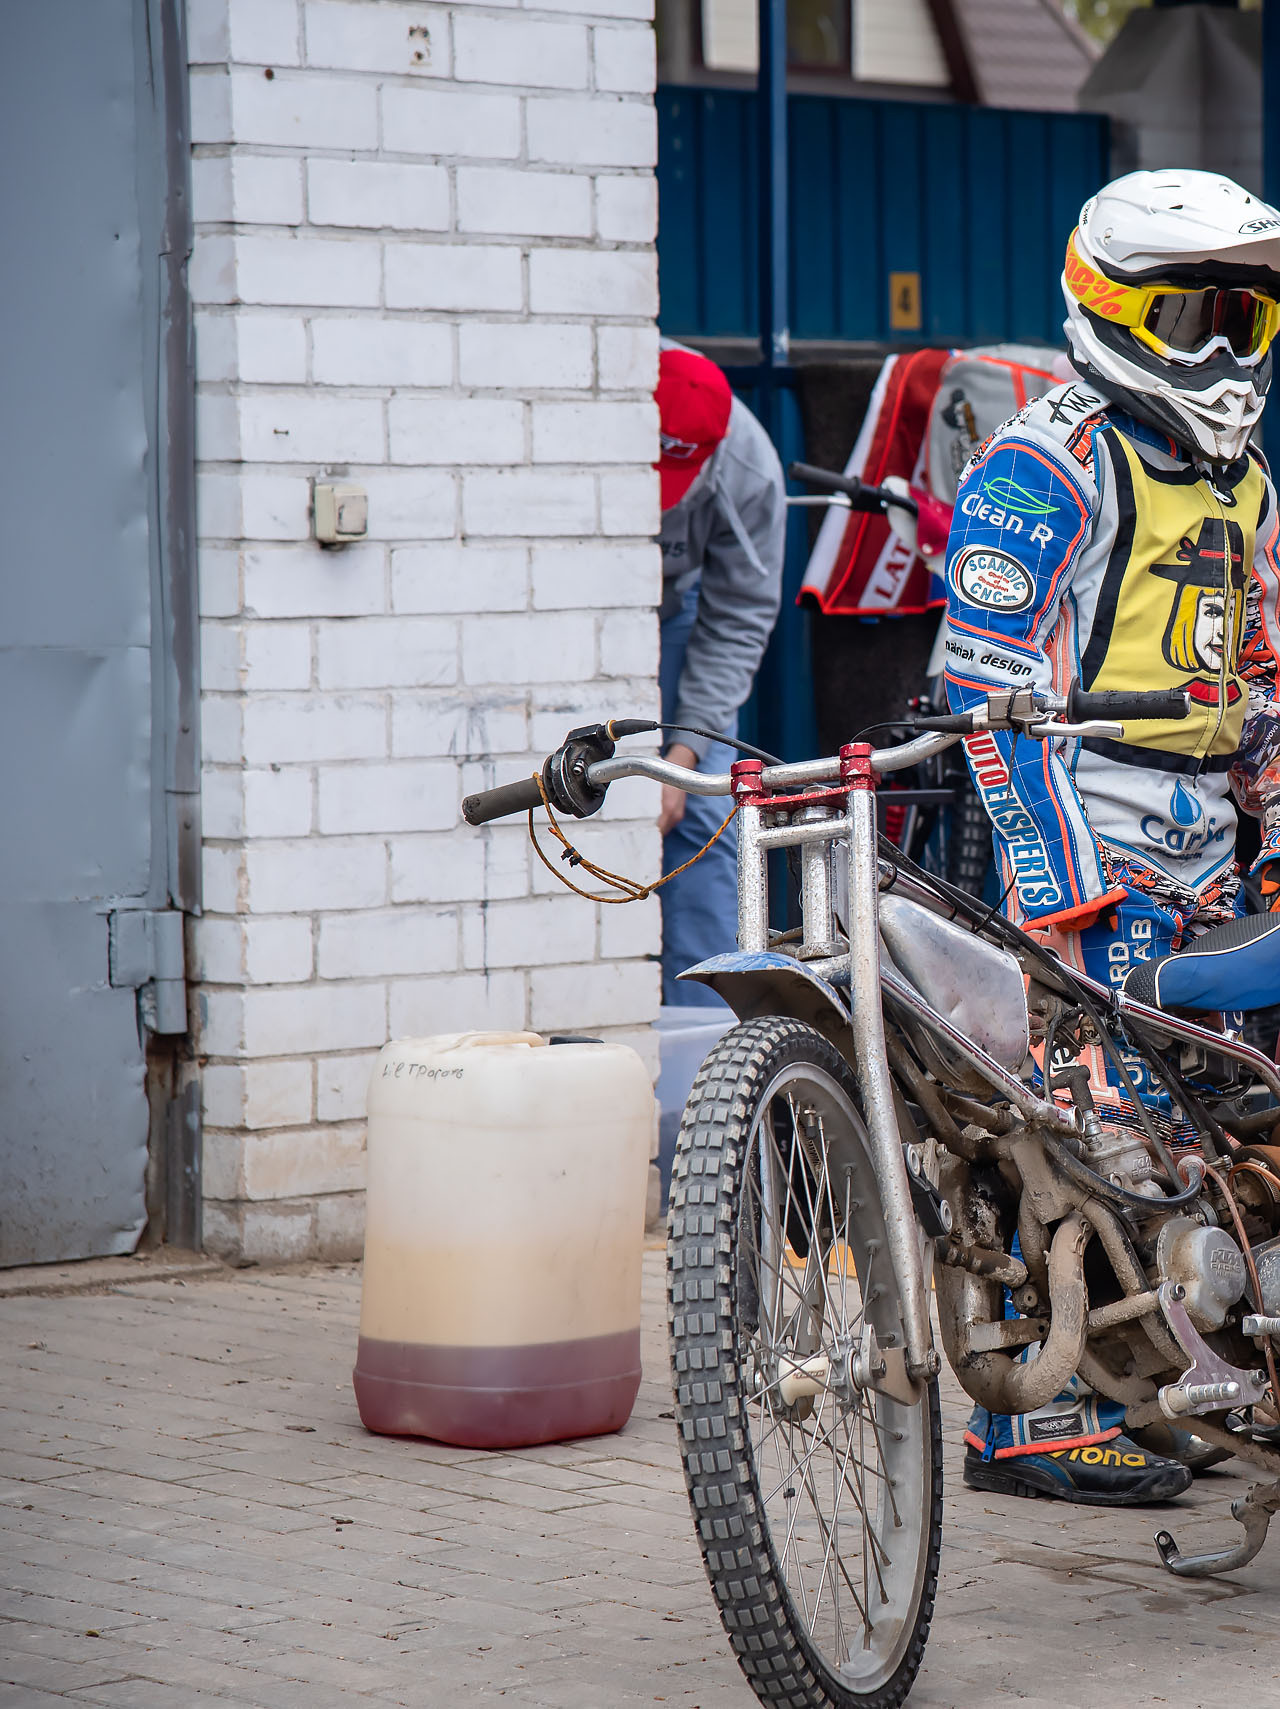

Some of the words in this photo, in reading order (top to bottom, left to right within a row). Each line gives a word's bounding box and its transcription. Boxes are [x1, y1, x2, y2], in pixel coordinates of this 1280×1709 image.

[961, 494, 1024, 534] Clean
[1029, 522, 1054, 549] R
[968, 556, 1026, 591] SCANDIC
[970, 582, 1003, 603] CNC
[980, 653, 1033, 676] design
